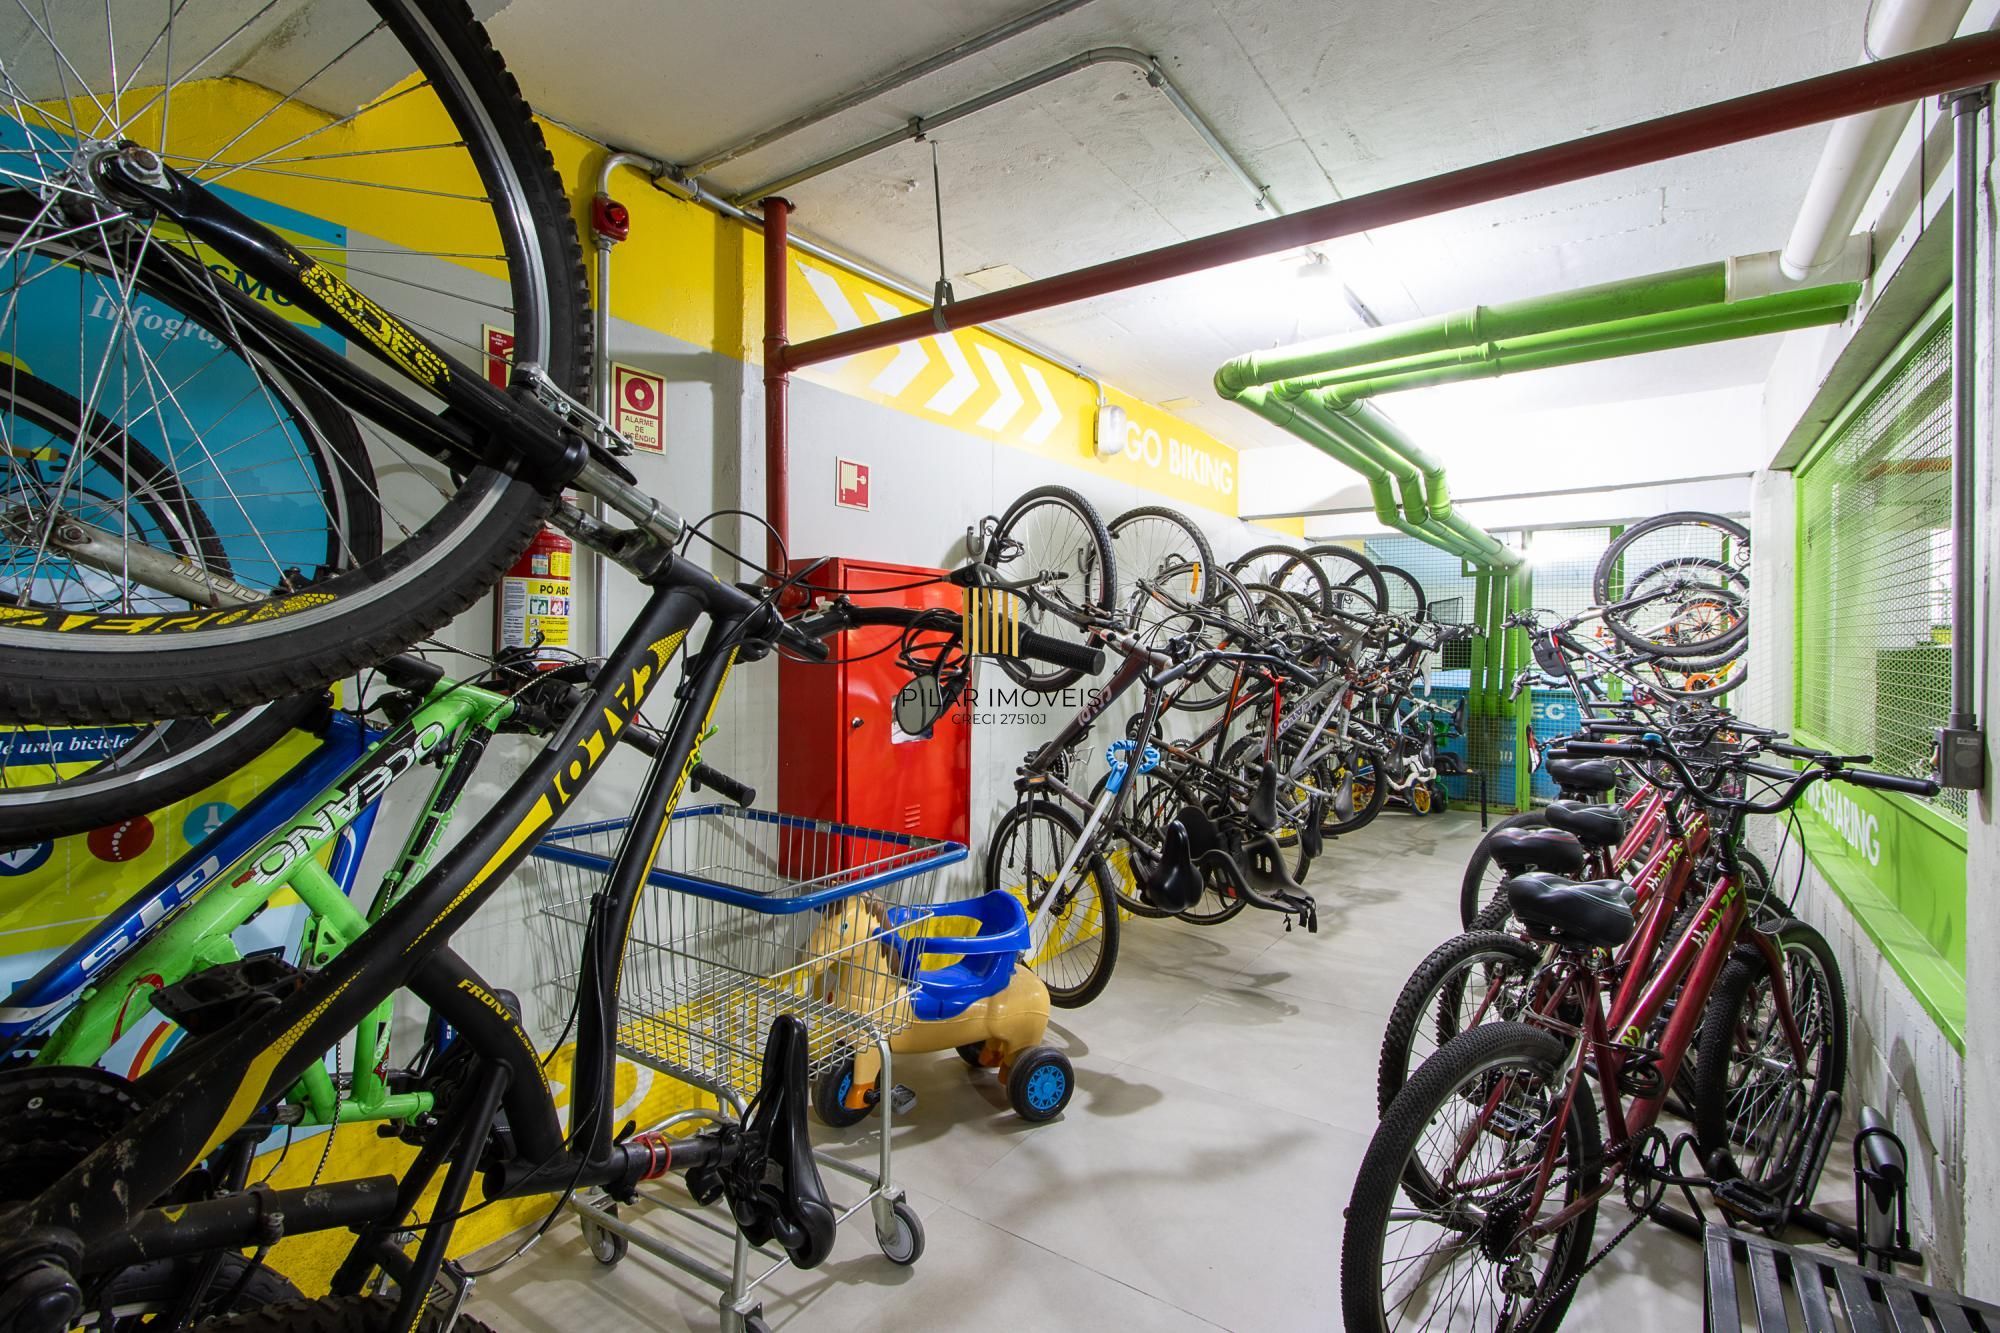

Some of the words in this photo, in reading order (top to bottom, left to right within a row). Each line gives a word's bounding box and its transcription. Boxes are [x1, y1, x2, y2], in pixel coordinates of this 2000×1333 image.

[622, 431, 656, 444] INCÊNDIO
[625, 415, 654, 428] ALARME
[634, 425, 645, 434] DE
[1125, 420, 1162, 468] GO
[1169, 437, 1233, 495] BIKING
[540, 583, 553, 595] PÓ
[20, 741, 63, 754] uma
[69, 734, 135, 751] bicicle
[252, 721, 445, 886] OCEANO
[1822, 780, 1880, 867] SHARING
[80, 855, 221, 979] GTS
[457, 978, 513, 1022] FRONT
